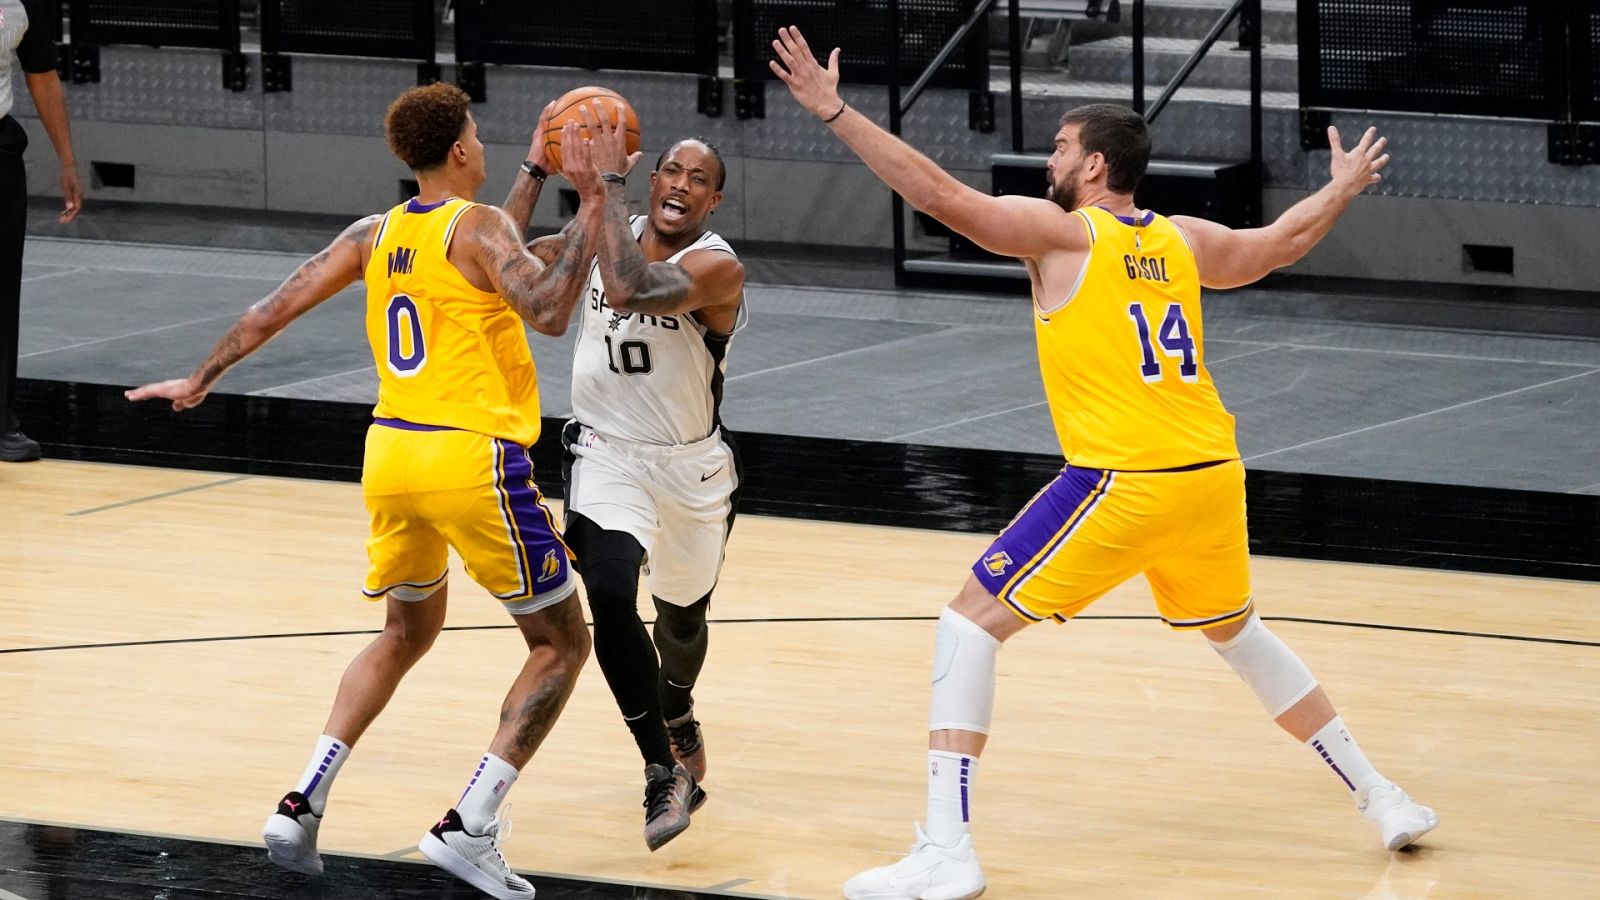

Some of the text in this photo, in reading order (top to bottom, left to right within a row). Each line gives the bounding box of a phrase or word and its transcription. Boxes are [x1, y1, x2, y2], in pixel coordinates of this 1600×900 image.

[387, 294, 427, 378] 0
[604, 335, 654, 376] 10
[1129, 303, 1199, 383] 14
